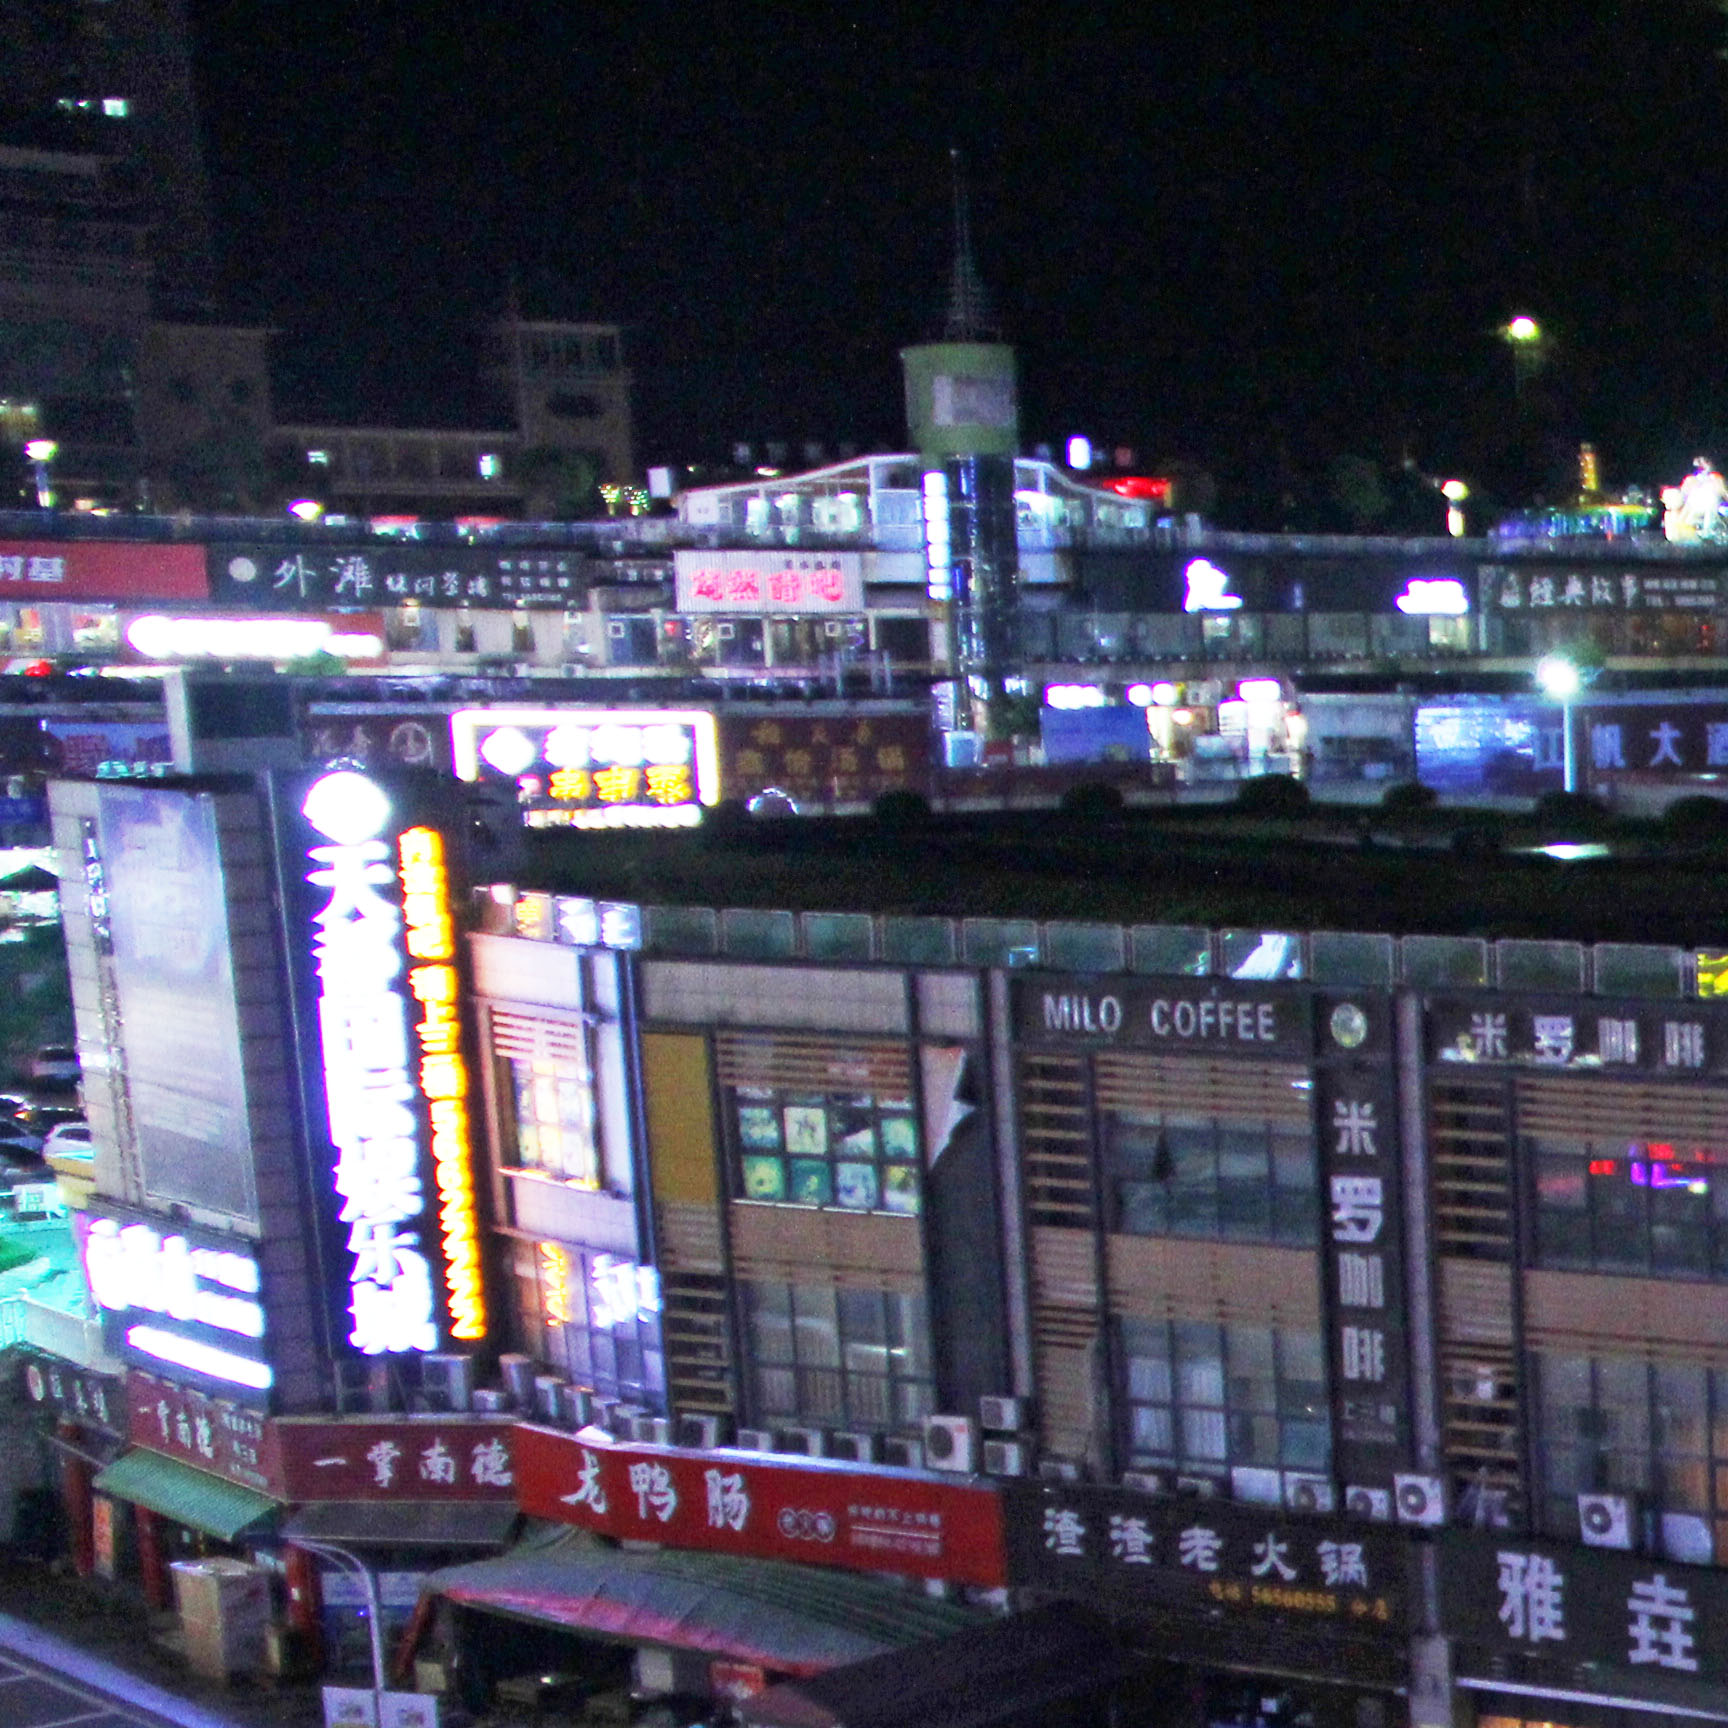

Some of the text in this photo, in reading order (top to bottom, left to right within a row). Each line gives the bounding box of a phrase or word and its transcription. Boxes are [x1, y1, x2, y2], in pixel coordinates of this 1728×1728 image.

[1042, 994, 1275, 1041] MILO COFFEE
[1330, 1099, 1384, 1383] 米罗咖啡
